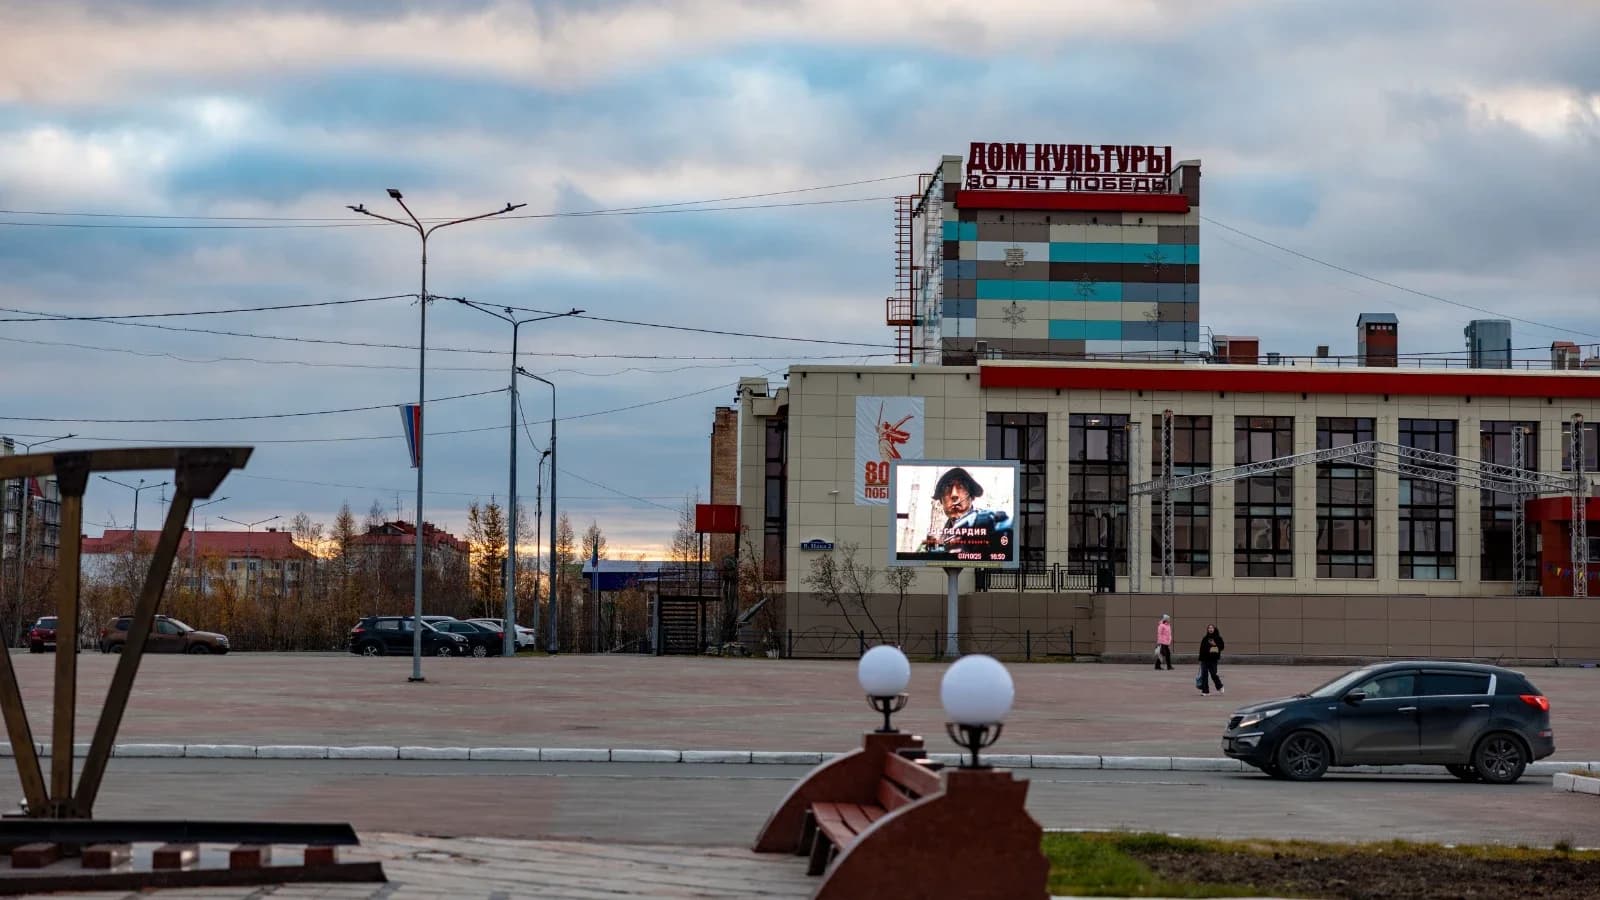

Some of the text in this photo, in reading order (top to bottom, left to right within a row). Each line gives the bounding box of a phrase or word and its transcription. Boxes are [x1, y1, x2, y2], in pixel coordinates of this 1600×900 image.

[967, 142, 1172, 174] ДОМ КУЛЬТУРЫ
[1007, 175, 1055, 191] ЛЕТ
[1065, 176, 1172, 192] ПОБЕДЫ
[864, 460, 890, 485] 80
